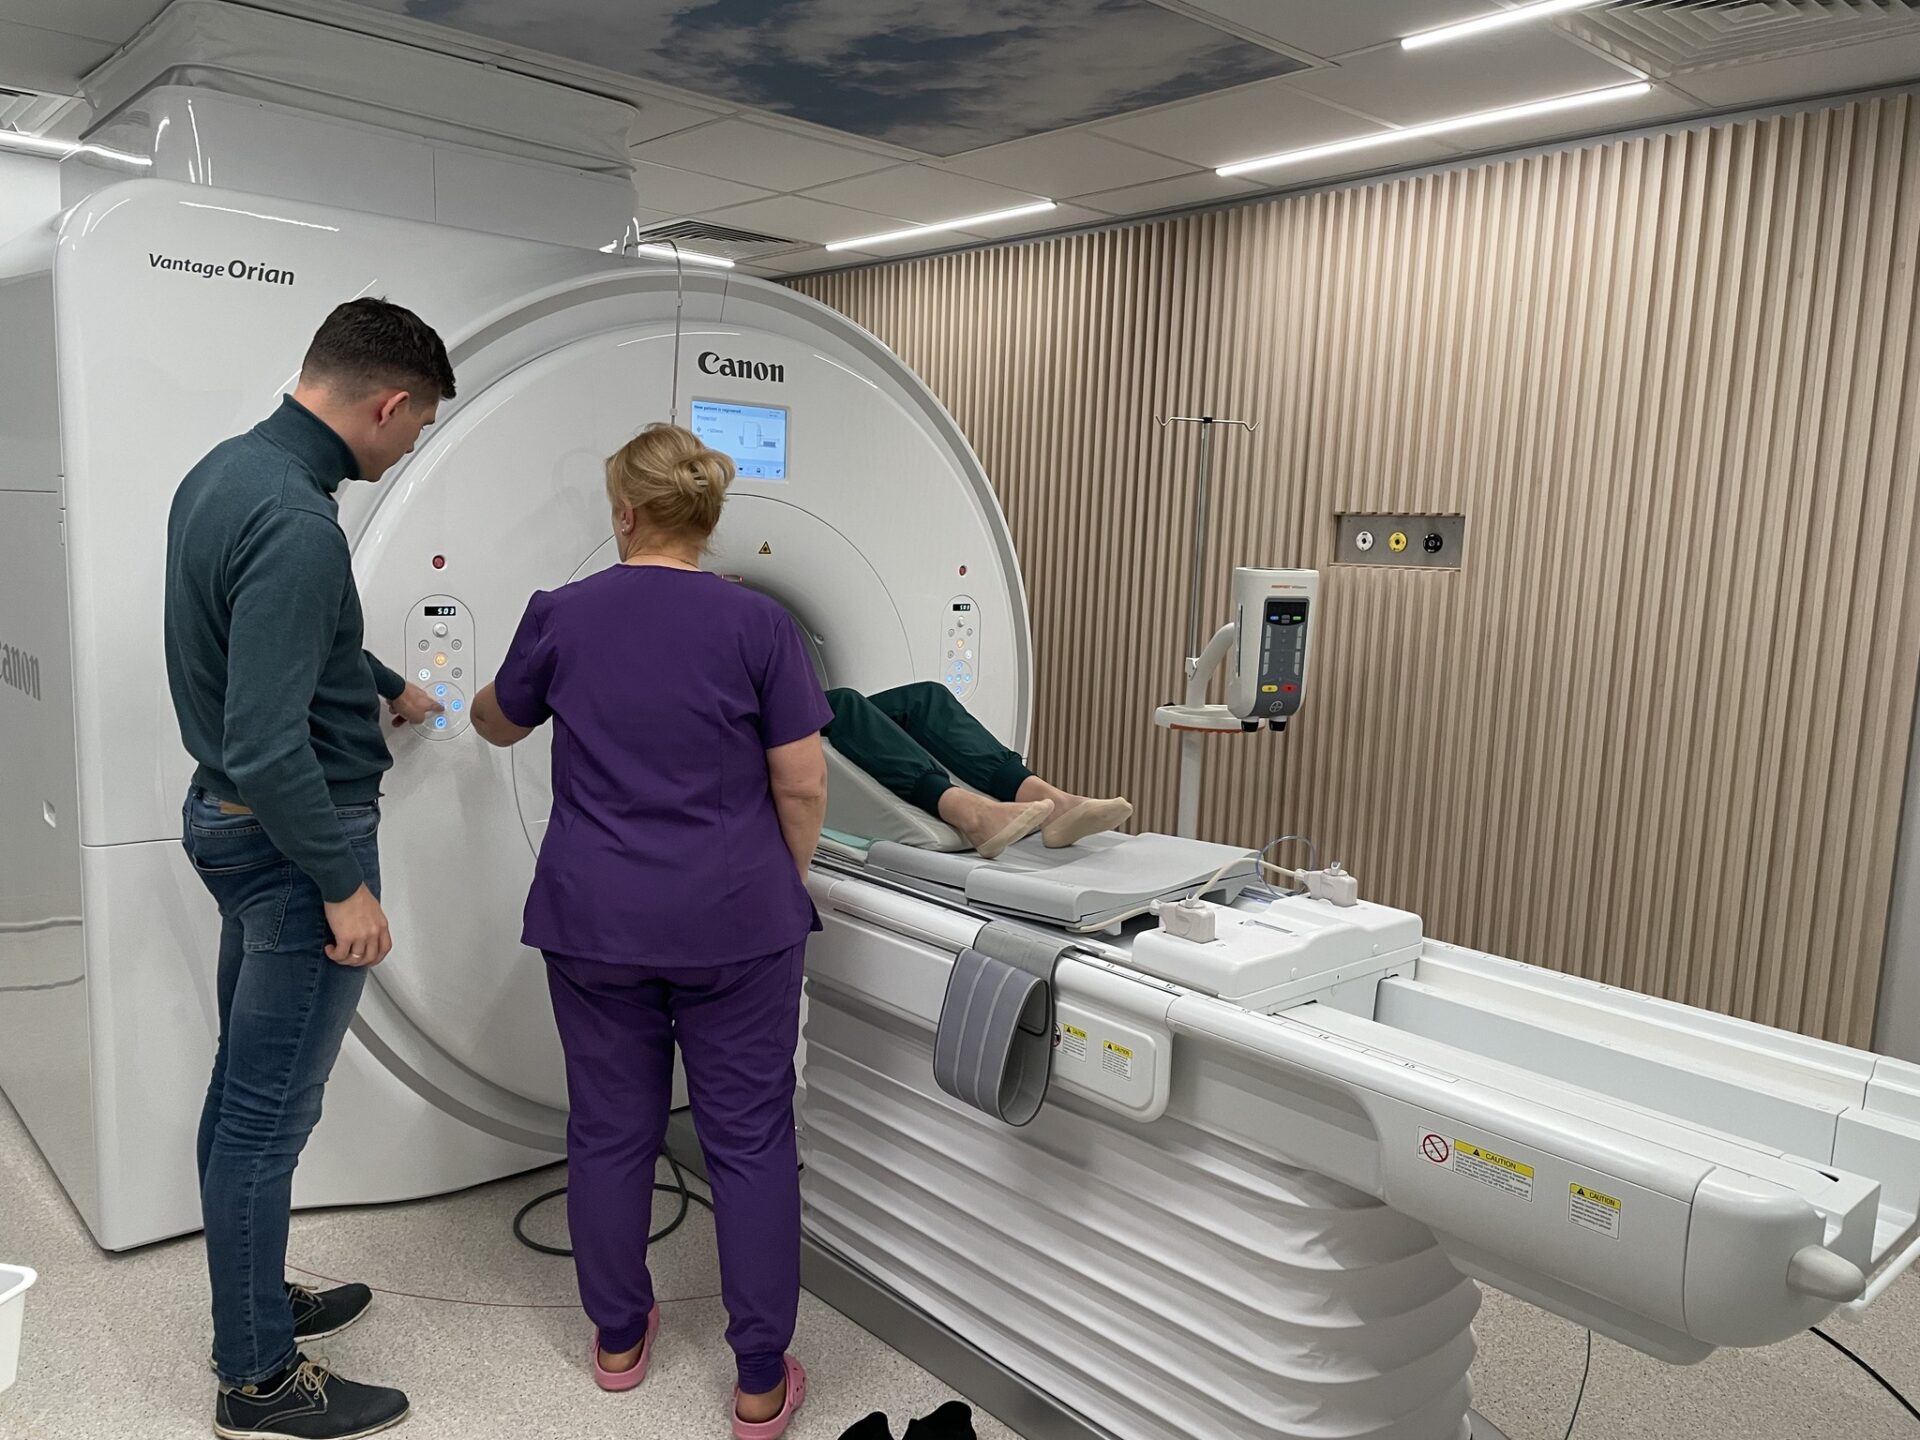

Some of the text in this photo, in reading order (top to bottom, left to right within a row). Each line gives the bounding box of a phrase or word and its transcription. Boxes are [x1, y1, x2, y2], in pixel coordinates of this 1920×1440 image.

[148, 253, 295, 286] Vantage Orian
[697, 351, 785, 383] Canon
[437, 607, 455, 615] 503
[0, 642, 41, 701] anon
[1485, 1153, 1517, 1170] CAUTION
[1589, 1192, 1615, 1206] CAUTION
